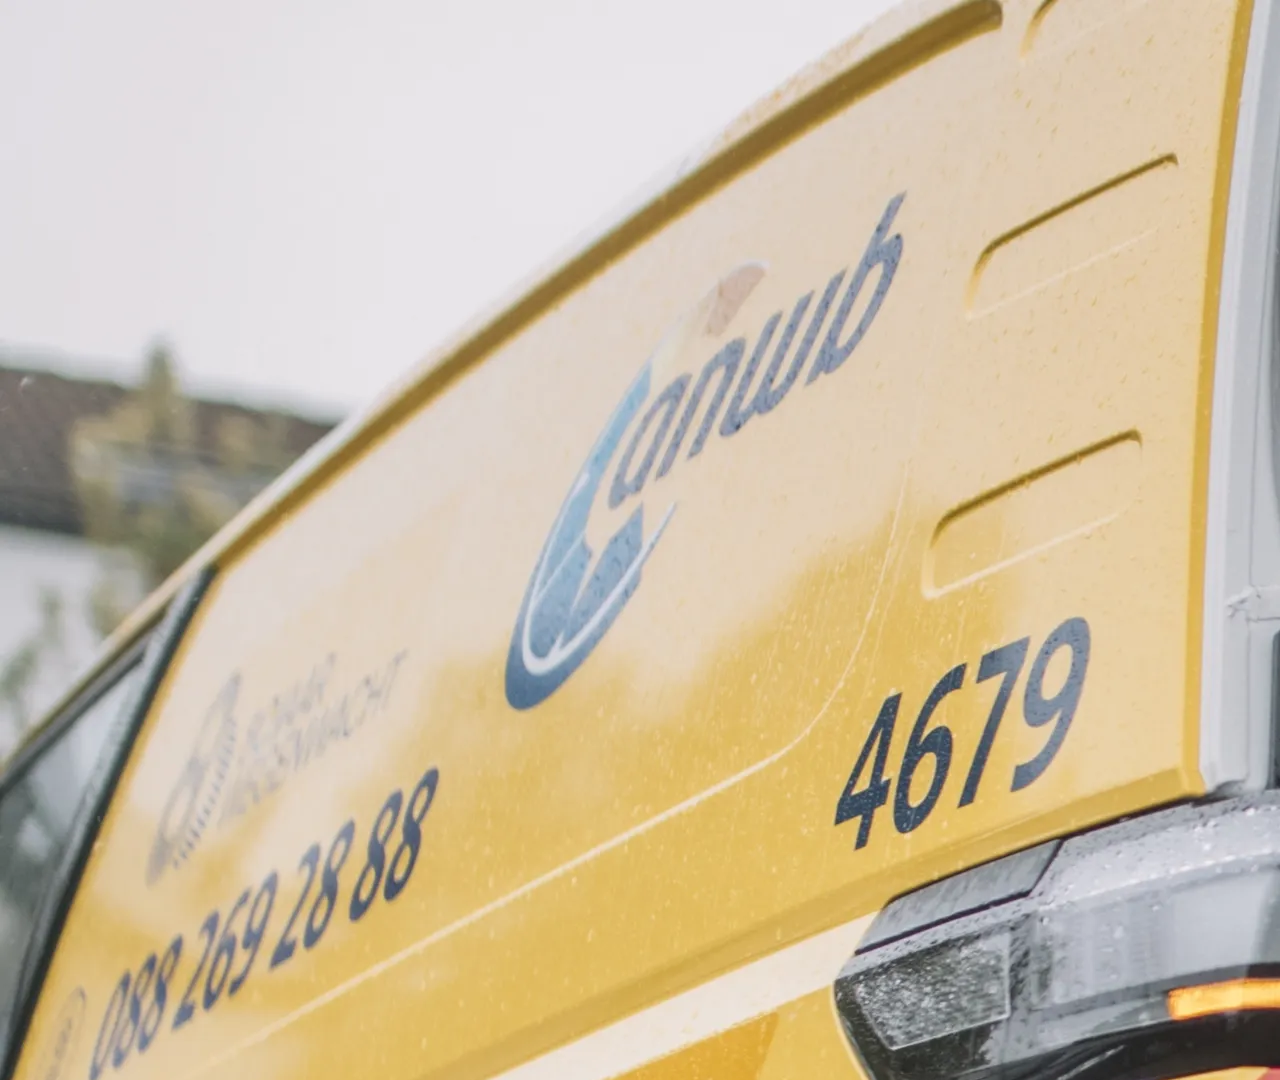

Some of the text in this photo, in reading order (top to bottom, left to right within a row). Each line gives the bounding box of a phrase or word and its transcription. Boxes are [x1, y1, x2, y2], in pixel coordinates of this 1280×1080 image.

[608, 191, 907, 509] anwb
[834, 617, 1091, 850] 4679
[172, 871, 278, 1031] 269
[268, 819, 355, 970] 28
[349, 767, 439, 922] 88
